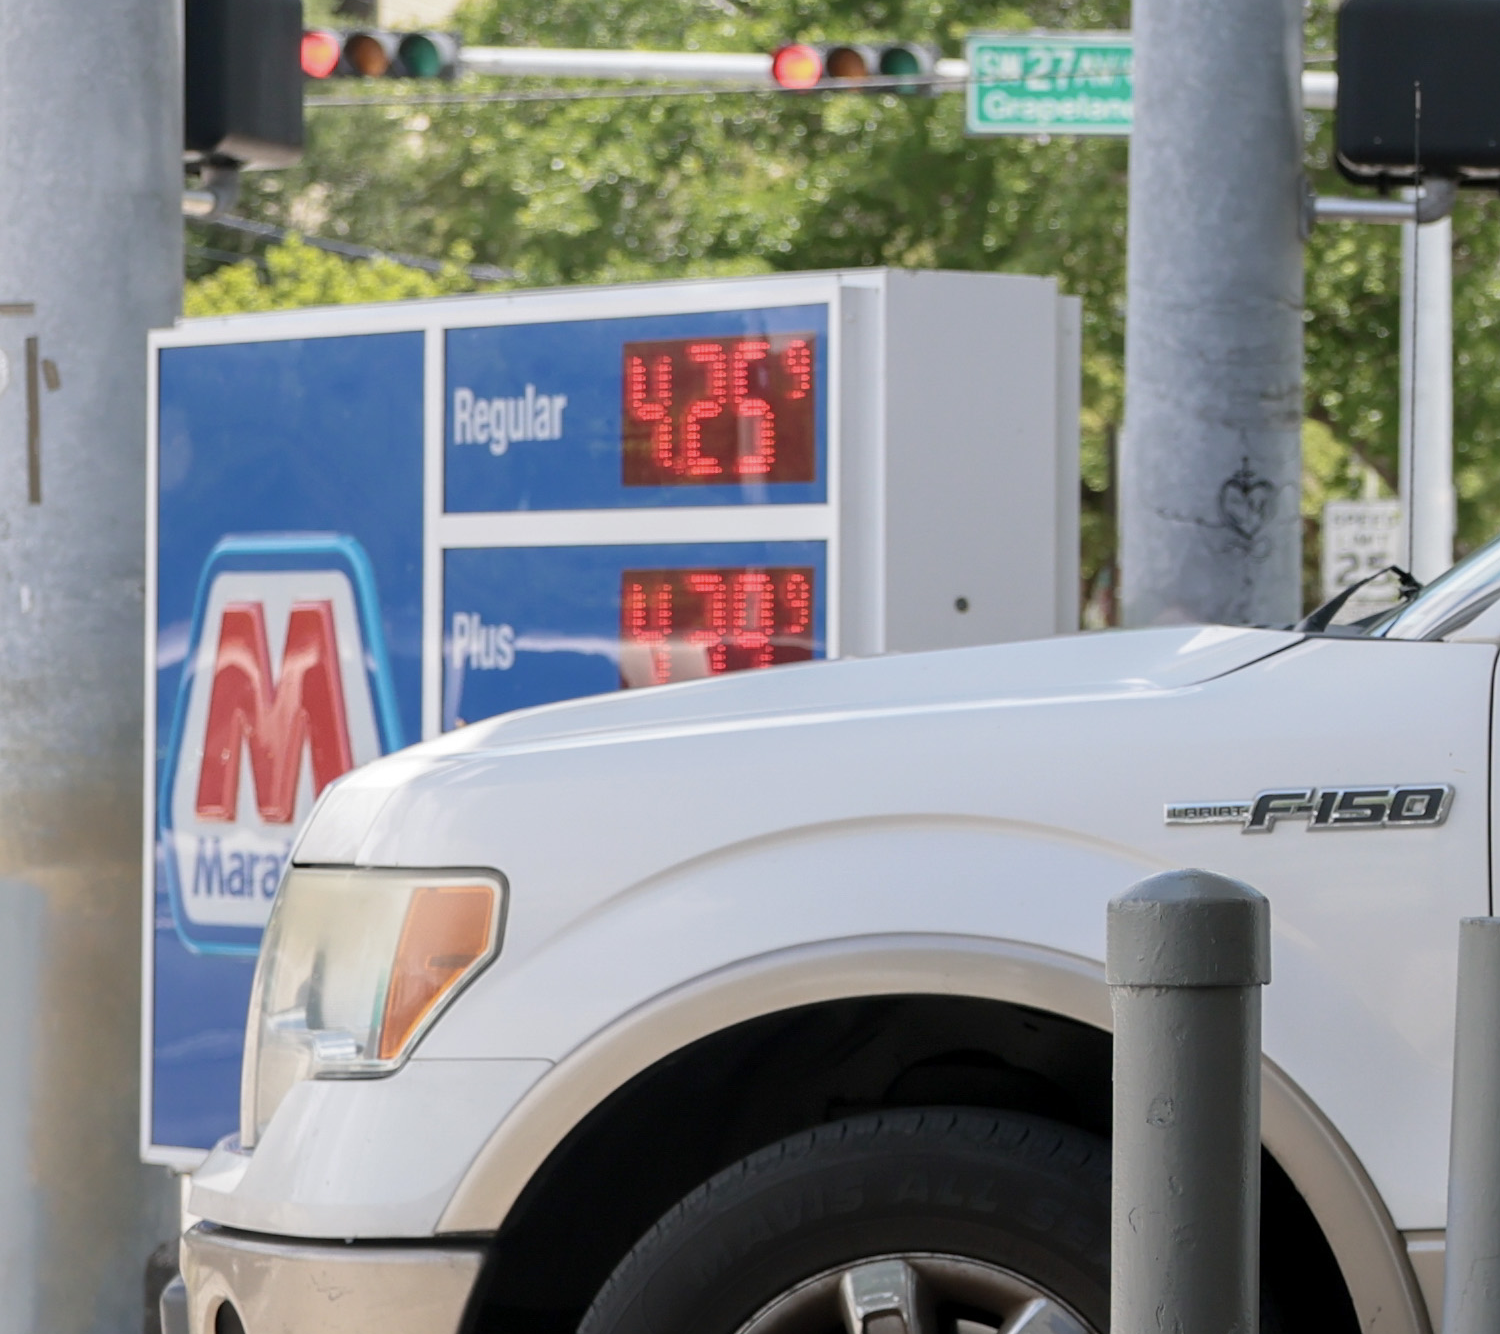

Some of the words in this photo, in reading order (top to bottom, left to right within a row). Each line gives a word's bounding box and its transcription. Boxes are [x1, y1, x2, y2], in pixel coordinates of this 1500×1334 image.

[1025, 48, 1076, 91] 27
[453, 383, 568, 456] Regular
[1336, 553, 1398, 586] 25
[452, 612, 515, 670] Plus
[196, 599, 353, 823] M
[1172, 805, 1248, 818] LARIAT
[1242, 783, 1455, 834] F-150
[192, 838, 290, 898] Mara
